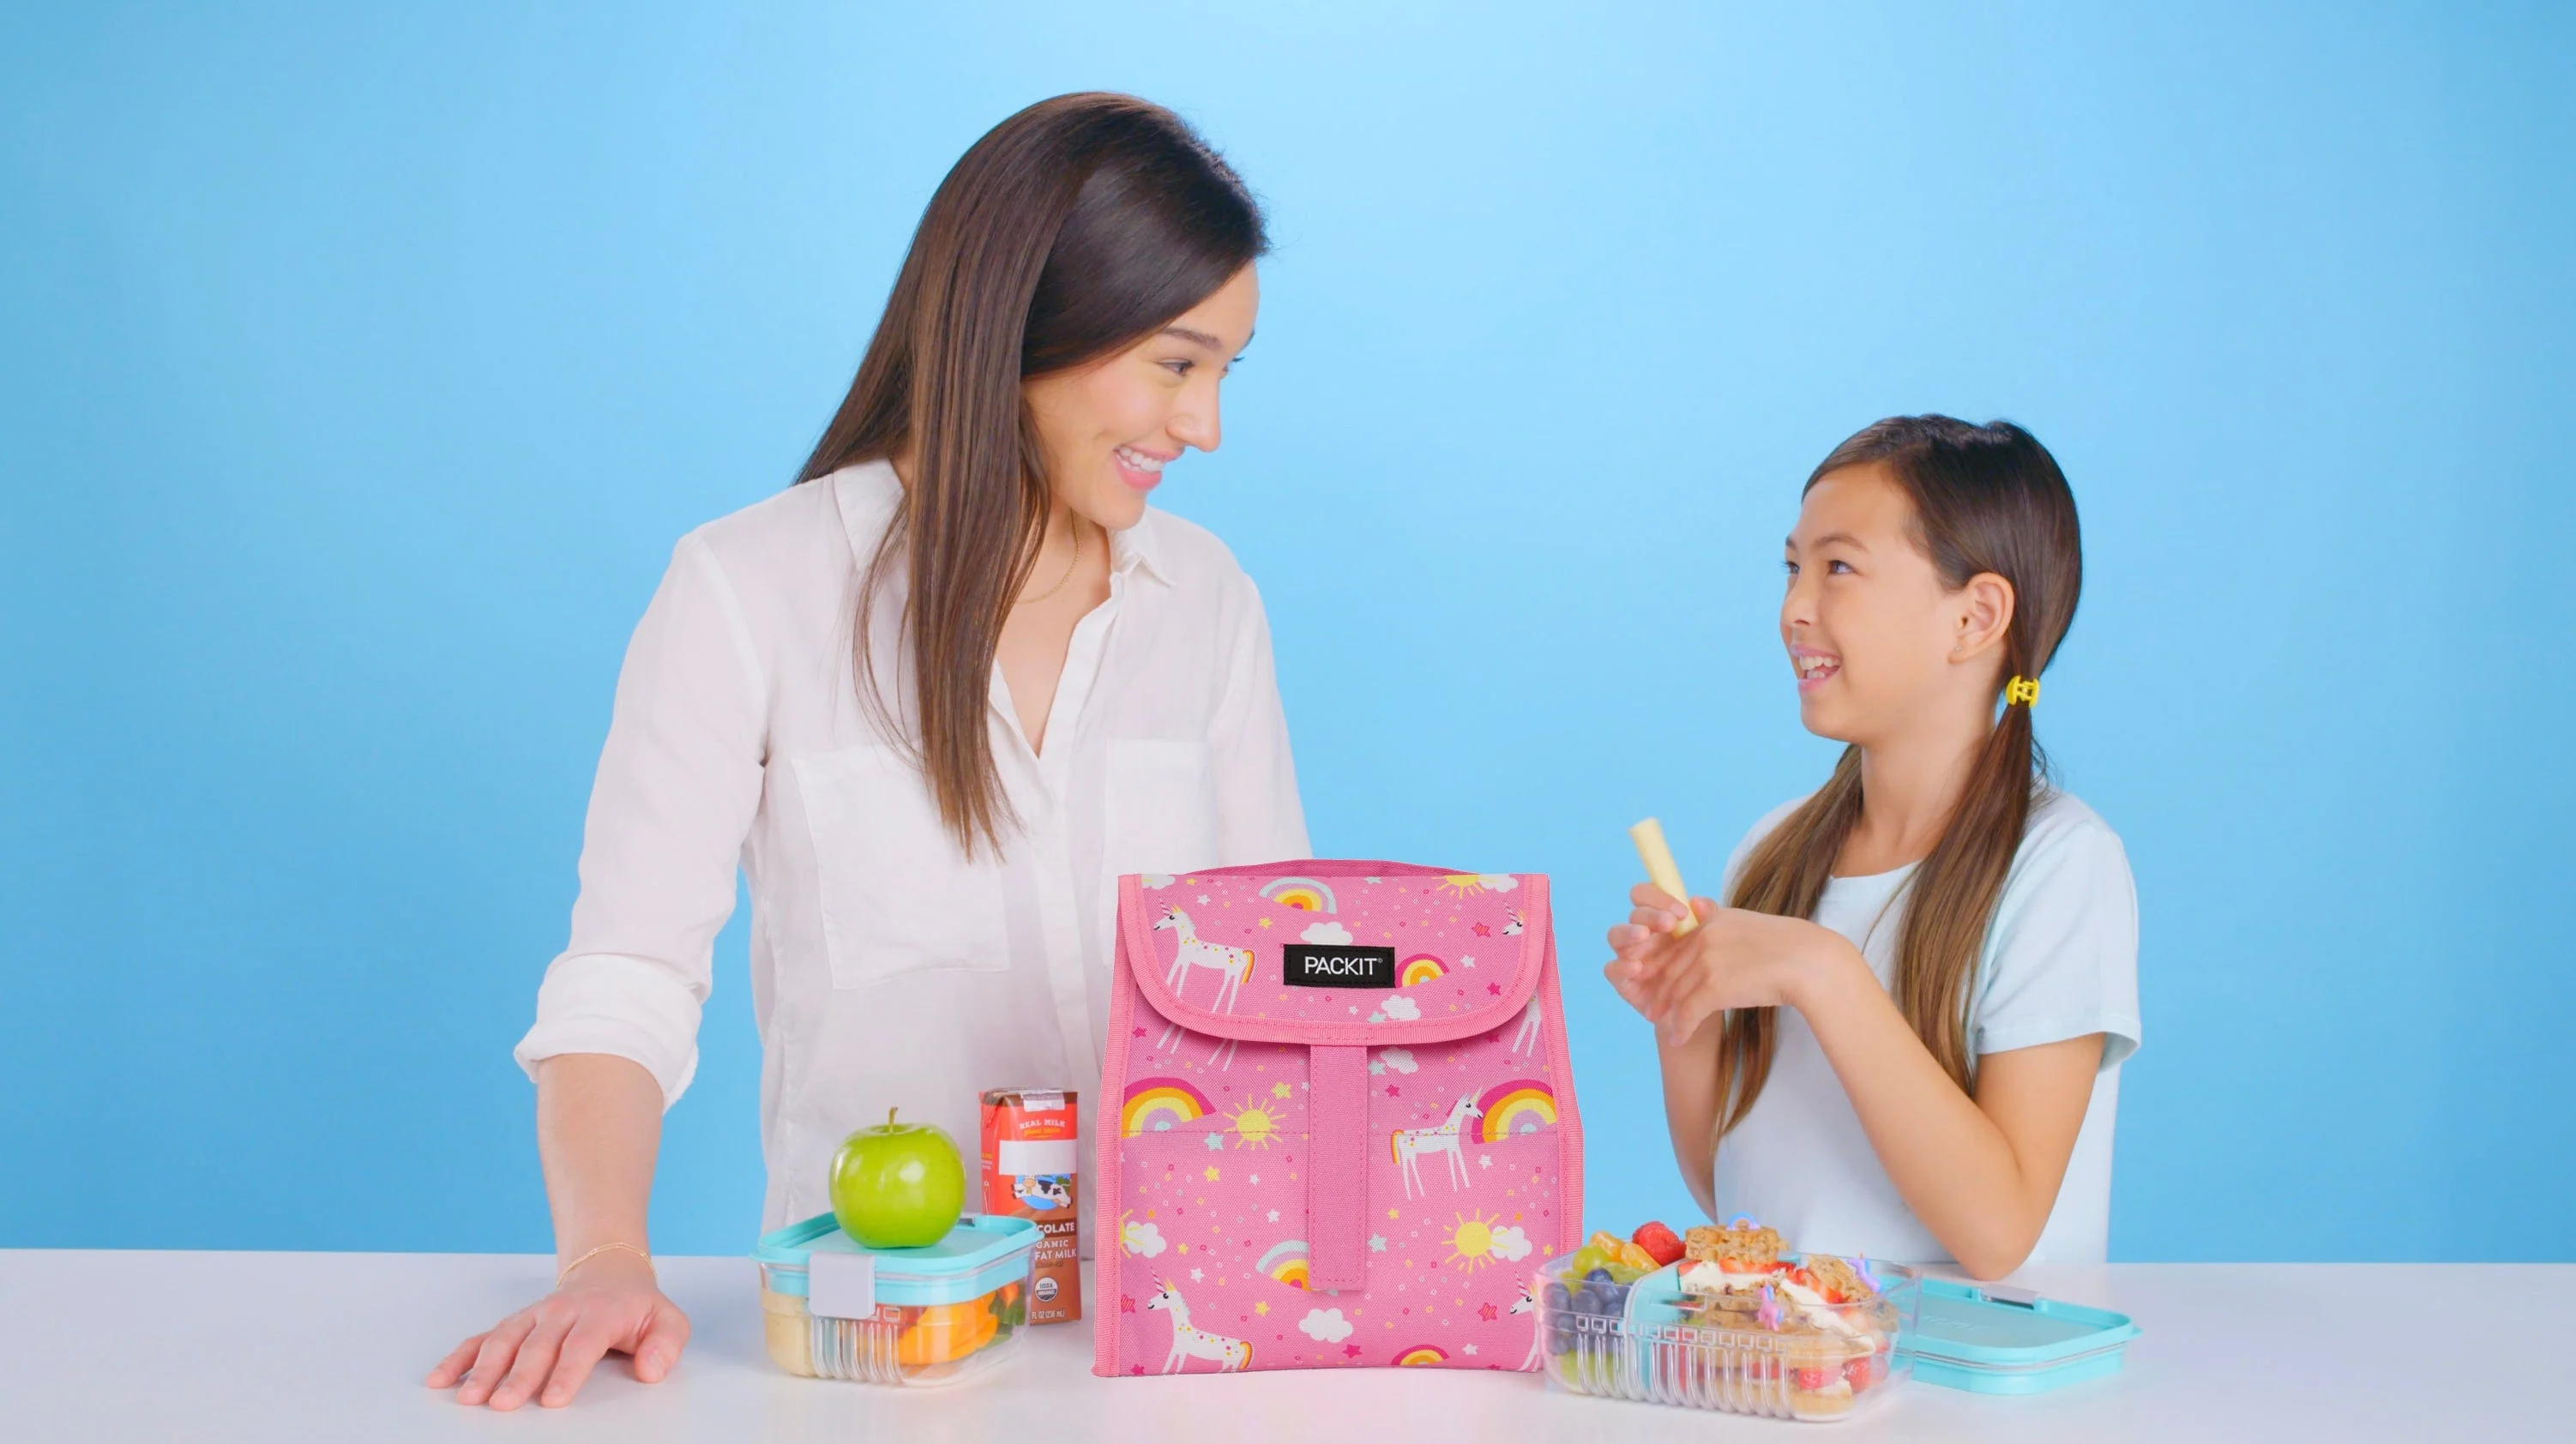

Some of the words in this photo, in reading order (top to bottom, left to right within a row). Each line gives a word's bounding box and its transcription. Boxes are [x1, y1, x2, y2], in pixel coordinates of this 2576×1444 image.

[1304, 956, 1377, 976] PACKIT
[1019, 1119, 1042, 1129] REAL
[1044, 1118, 1066, 1128] MILK
[1036, 1222, 1075, 1234] COLATE
[1035, 1239, 1068, 1248] GANIC
[1055, 1248, 1077, 1260] MILK
